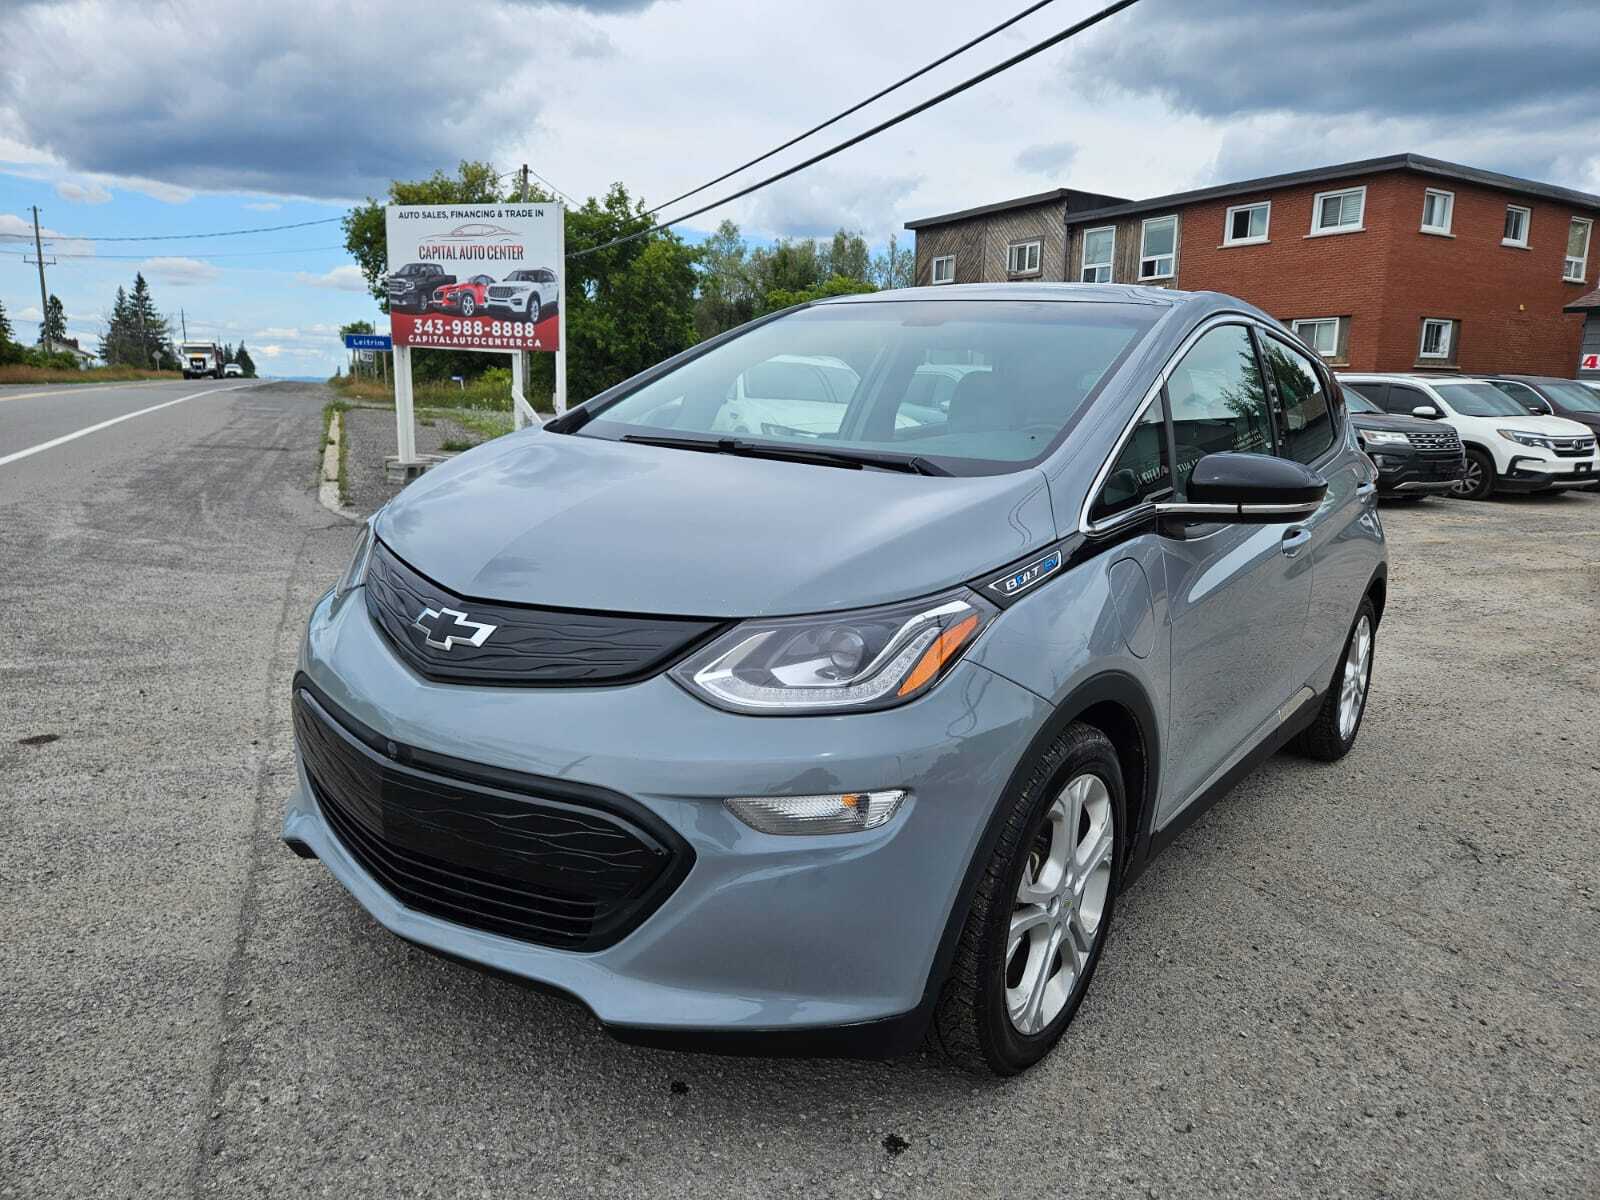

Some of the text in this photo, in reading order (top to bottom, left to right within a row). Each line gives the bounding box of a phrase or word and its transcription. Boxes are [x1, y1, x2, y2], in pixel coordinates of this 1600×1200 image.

[399, 211, 420, 219] AUTO
[422, 210, 449, 219] SALES,
[450, 210, 496, 218] FINANCING
[505, 209, 533, 217] TRADE
[535, 209, 544, 217] IN
[418, 245, 524, 260] CAPITAL AUTO CENTER
[413, 319, 535, 337] 343-988-8888
[353, 337, 385, 347] Leitrim
[408, 334, 542, 347] CAPITALAUTOCENTER.CA
[1006, 556, 1058, 590] BOLT EV
